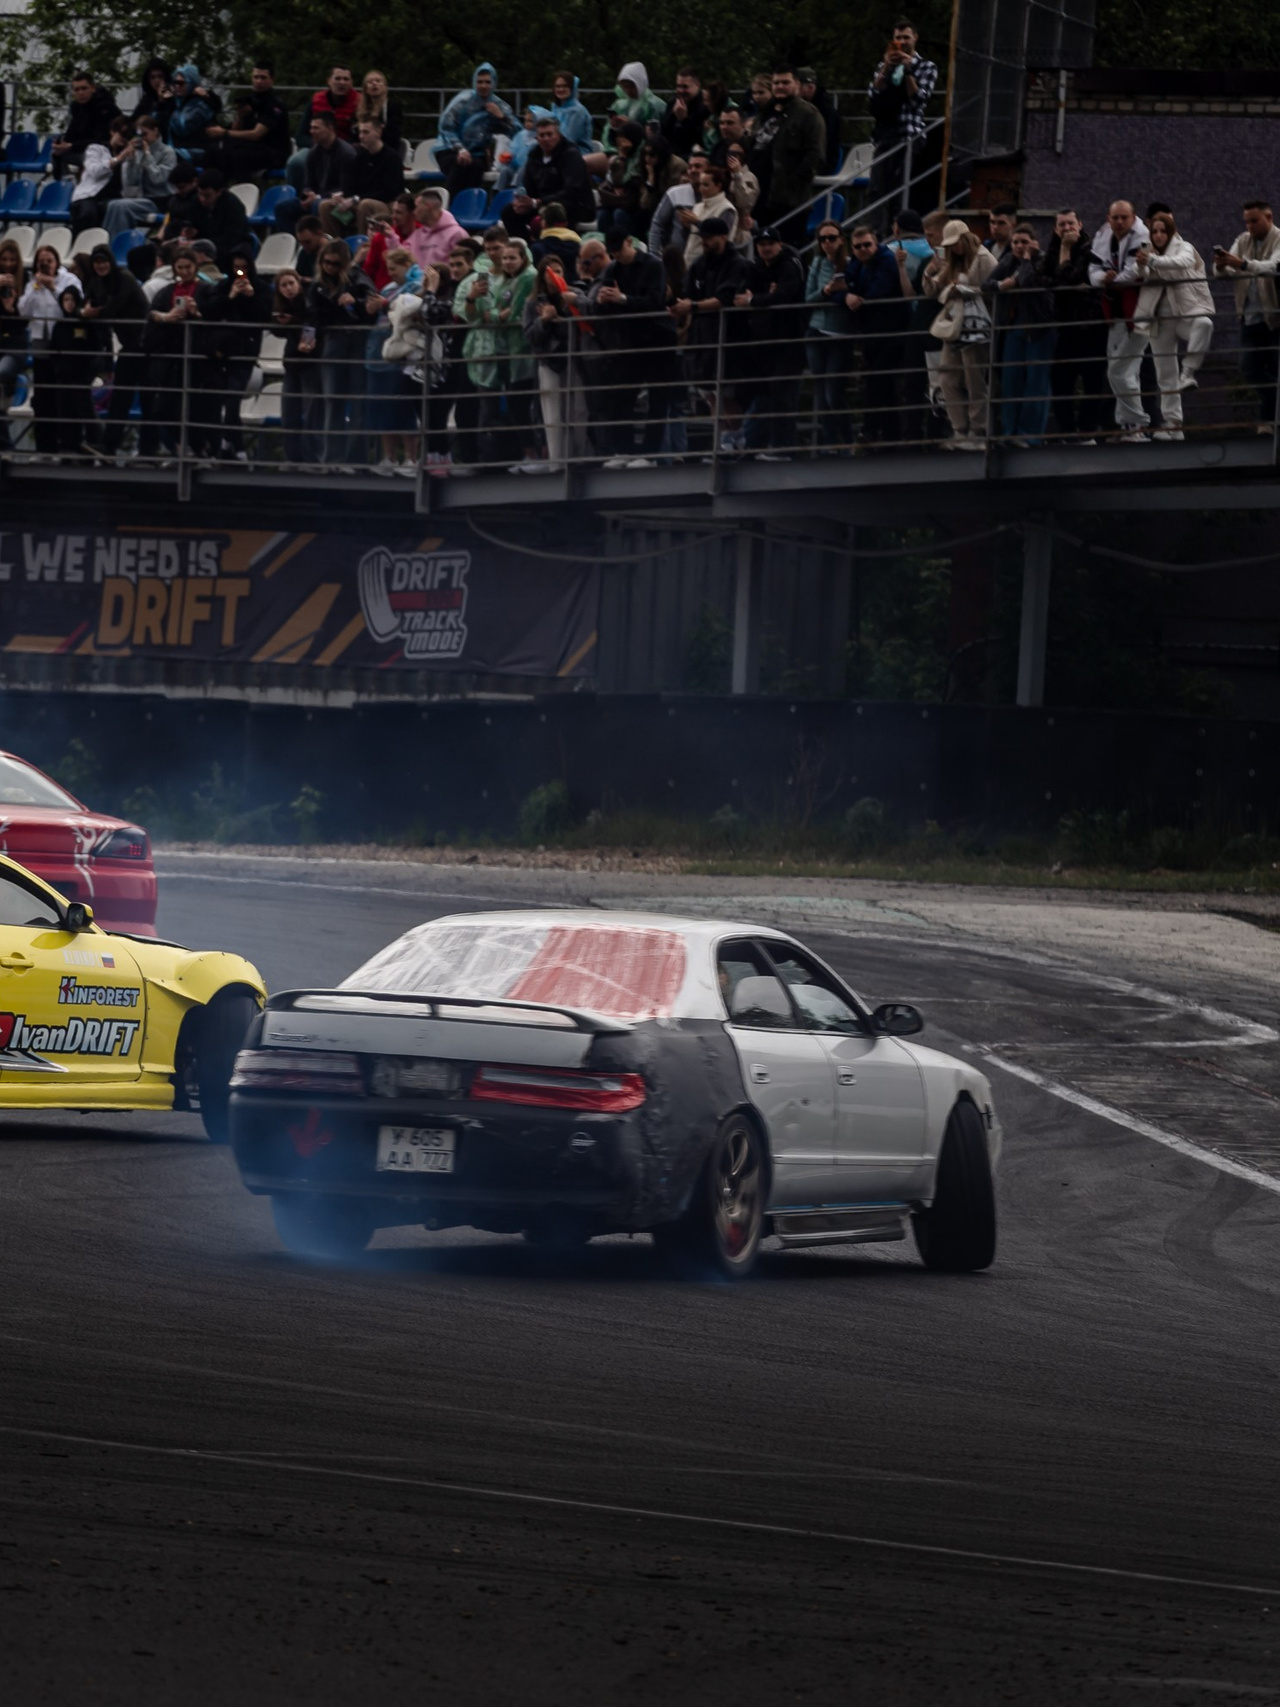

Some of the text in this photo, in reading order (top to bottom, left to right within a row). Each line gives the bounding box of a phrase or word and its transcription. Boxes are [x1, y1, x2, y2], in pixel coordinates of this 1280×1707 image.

[22, 532, 89, 582] WE
[93, 535, 181, 583] NEED
[187, 538, 222, 578] IS
[391, 558, 466, 591] DRIFT
[95, 576, 252, 647] DRIFT
[403, 610, 460, 631] TRACK
[409, 631, 462, 652] MODE
[58, 976, 140, 1007] KINFOREST
[8, 1014, 140, 1056] IvanDRIFT
